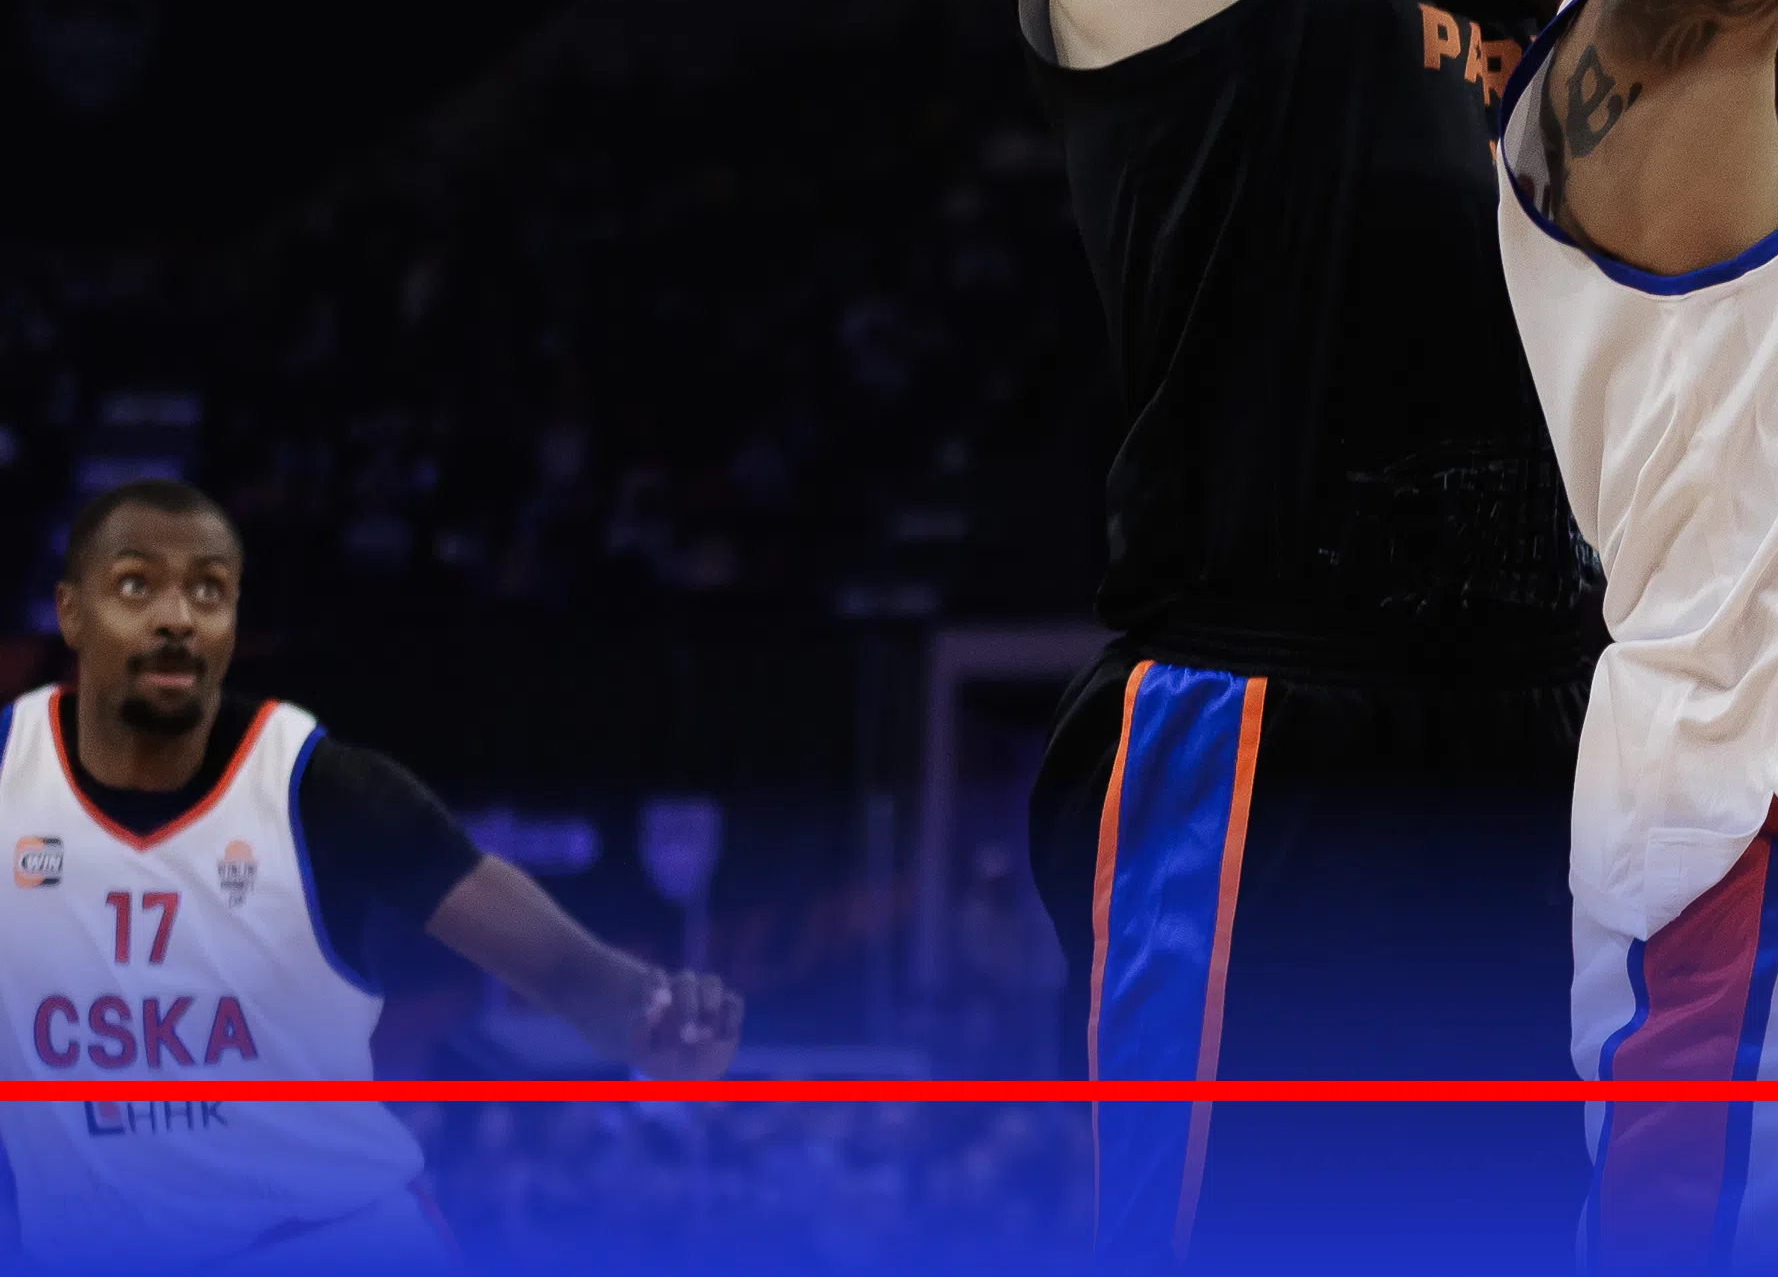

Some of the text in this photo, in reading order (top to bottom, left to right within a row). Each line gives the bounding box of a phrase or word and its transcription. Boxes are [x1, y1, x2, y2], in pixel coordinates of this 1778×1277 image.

[1418, 2, 1526, 107] PAR
[105, 890, 181, 966] 17
[33, 994, 259, 1070] CSKA
